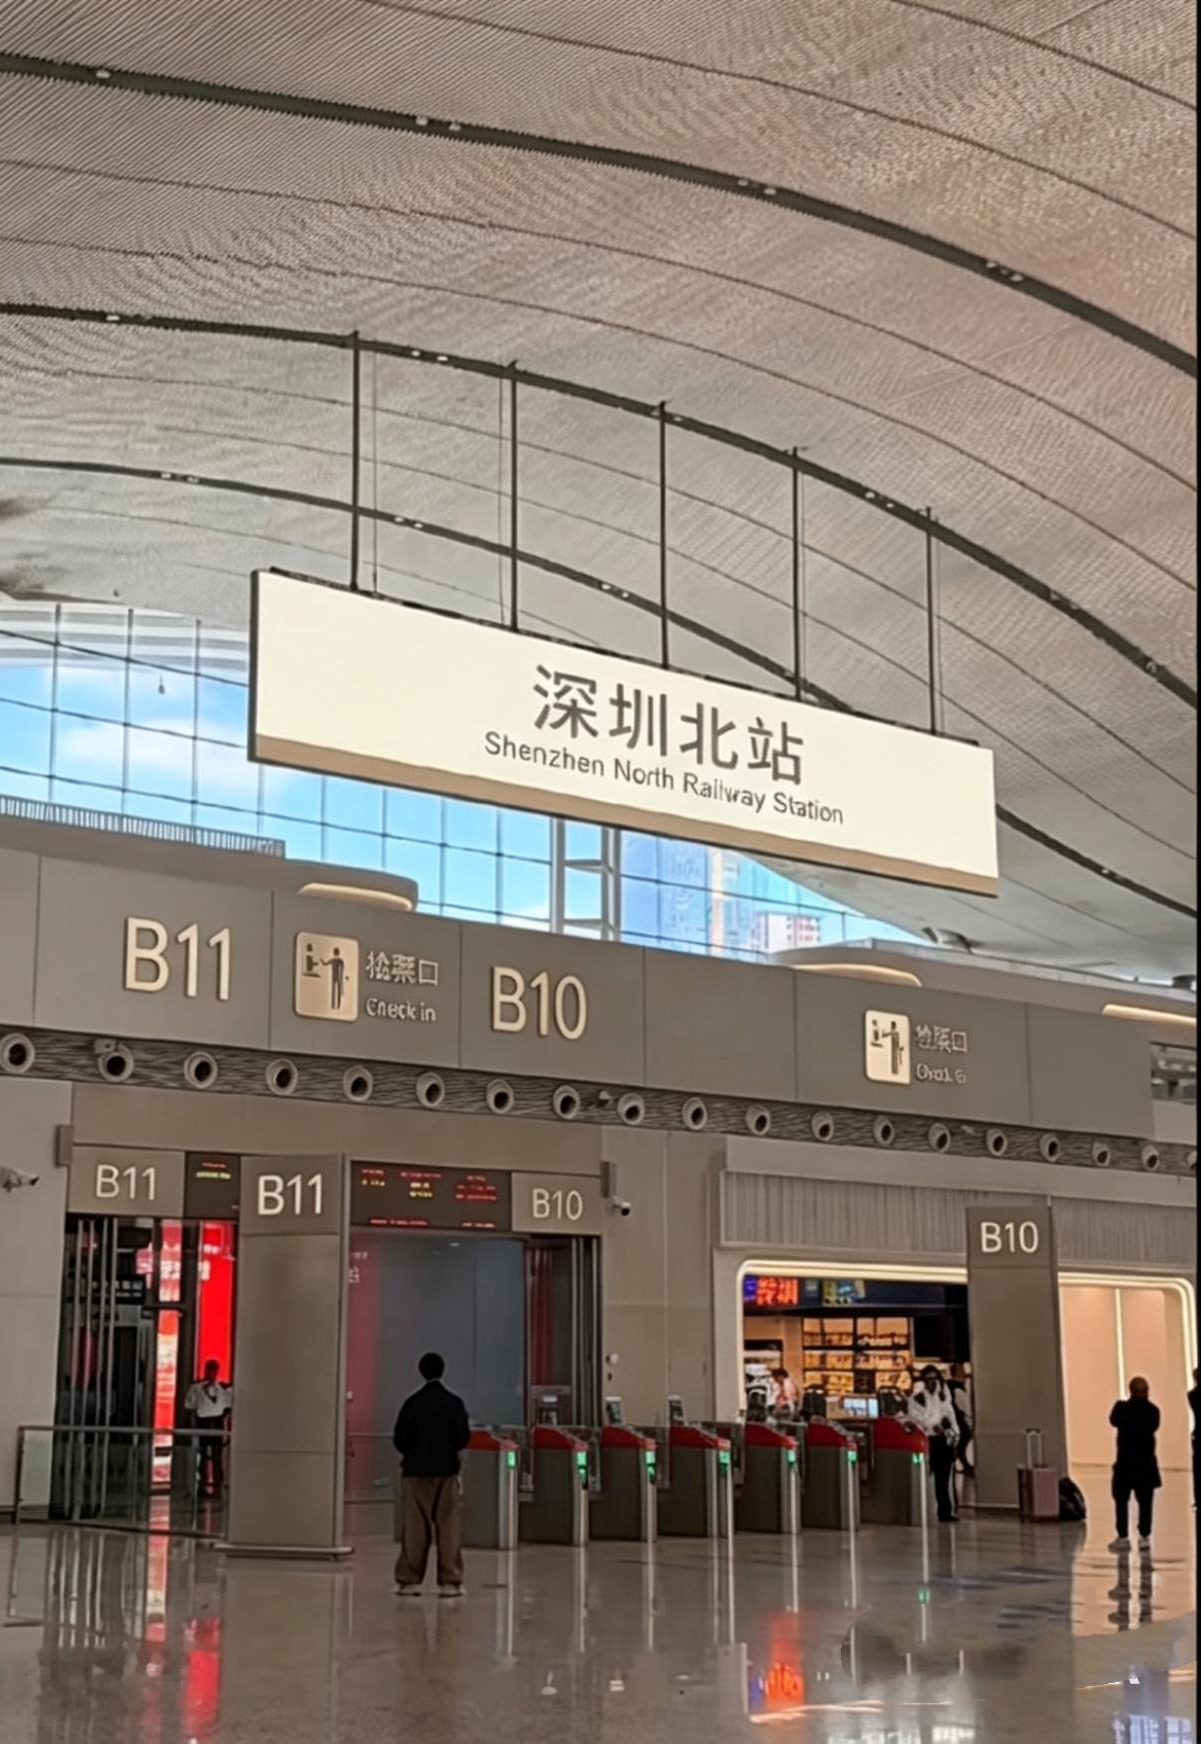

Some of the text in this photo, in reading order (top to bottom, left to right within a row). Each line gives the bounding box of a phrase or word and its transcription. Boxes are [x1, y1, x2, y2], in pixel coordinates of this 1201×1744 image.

[533, 664, 804, 786] 深圳北站
[484, 731, 844, 825] Shenzhen North Railway Station
[125, 916, 231, 1001] B11
[420, 1001, 437, 1021] in
[491, 966, 587, 1040] B10
[96, 1165, 156, 1200] B11
[257, 1172, 323, 1215] B11
[531, 1189, 584, 1222] B10
[980, 1221, 1039, 1254] B10
